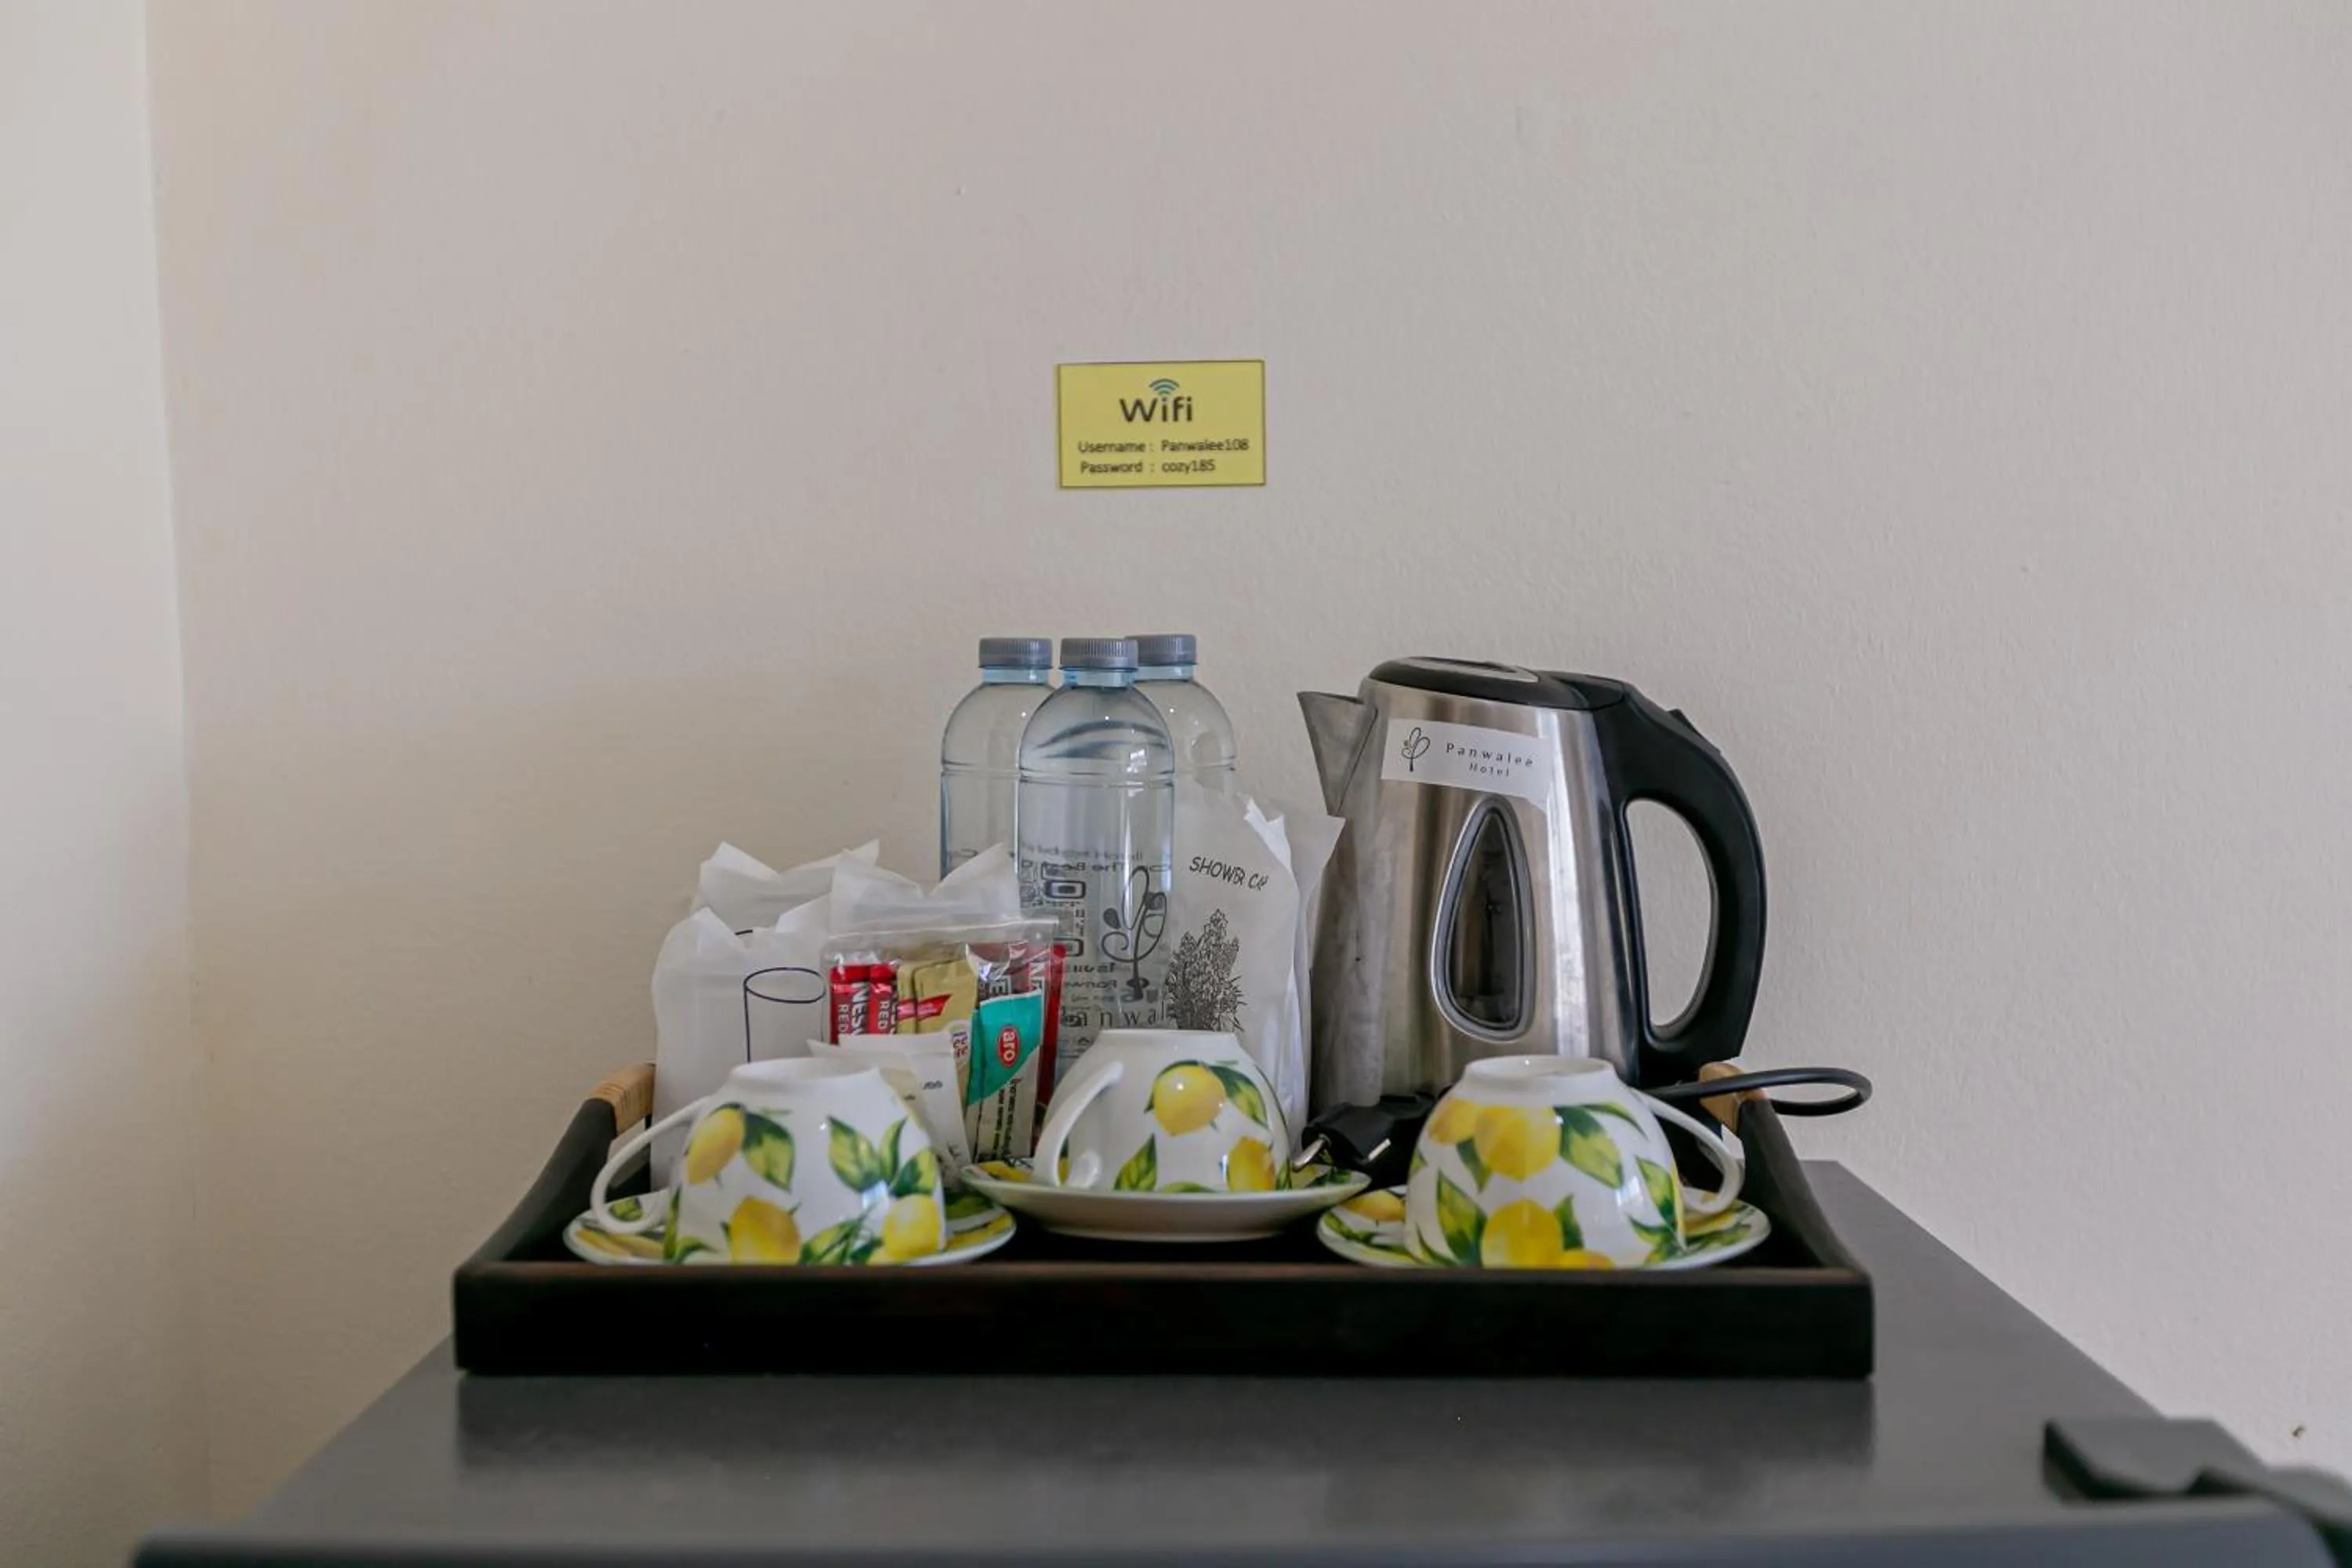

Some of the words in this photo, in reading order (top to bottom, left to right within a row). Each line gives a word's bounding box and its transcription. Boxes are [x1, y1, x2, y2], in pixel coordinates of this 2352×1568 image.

[1119, 396, 1192, 423] Wifi
[1078, 440, 1145, 453] Username
[1080, 459, 1143, 474] Password
[1160, 459, 1216, 474] cozy185
[1446, 742, 1534, 767] Panwalee
[1468, 762, 1510, 777] Hotel
[877, 1000, 891, 1029] RED
[1003, 1030, 1016, 1062] aro
